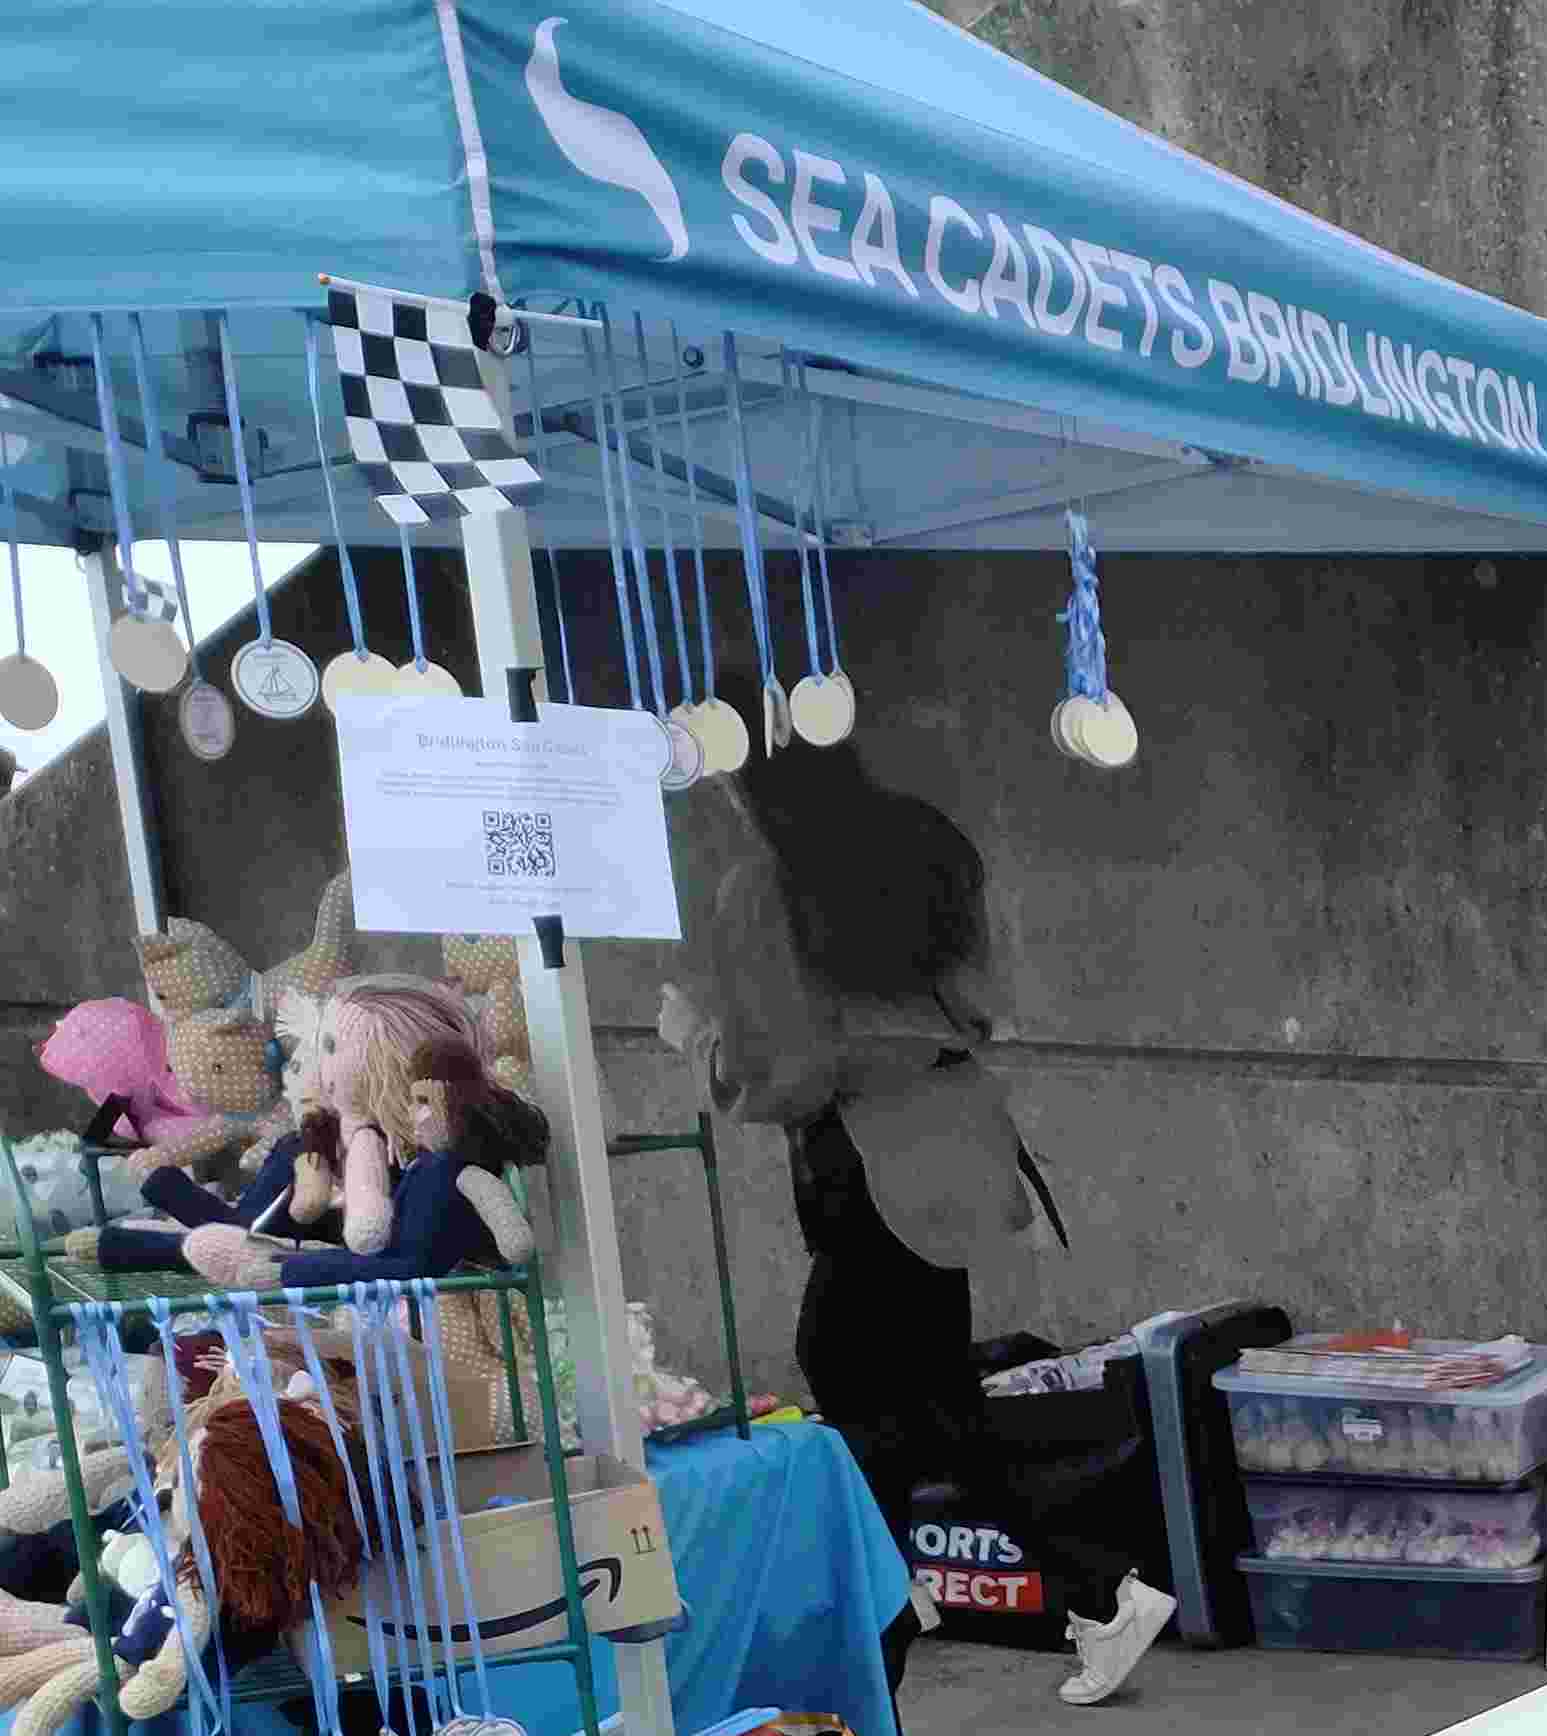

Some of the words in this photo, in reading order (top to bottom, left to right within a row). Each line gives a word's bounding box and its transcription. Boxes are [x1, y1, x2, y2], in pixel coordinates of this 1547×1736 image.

[722, 132, 918, 296] SEA
[925, 195, 1213, 368] CADETS
[909, 1524, 1023, 1563] ORTS
